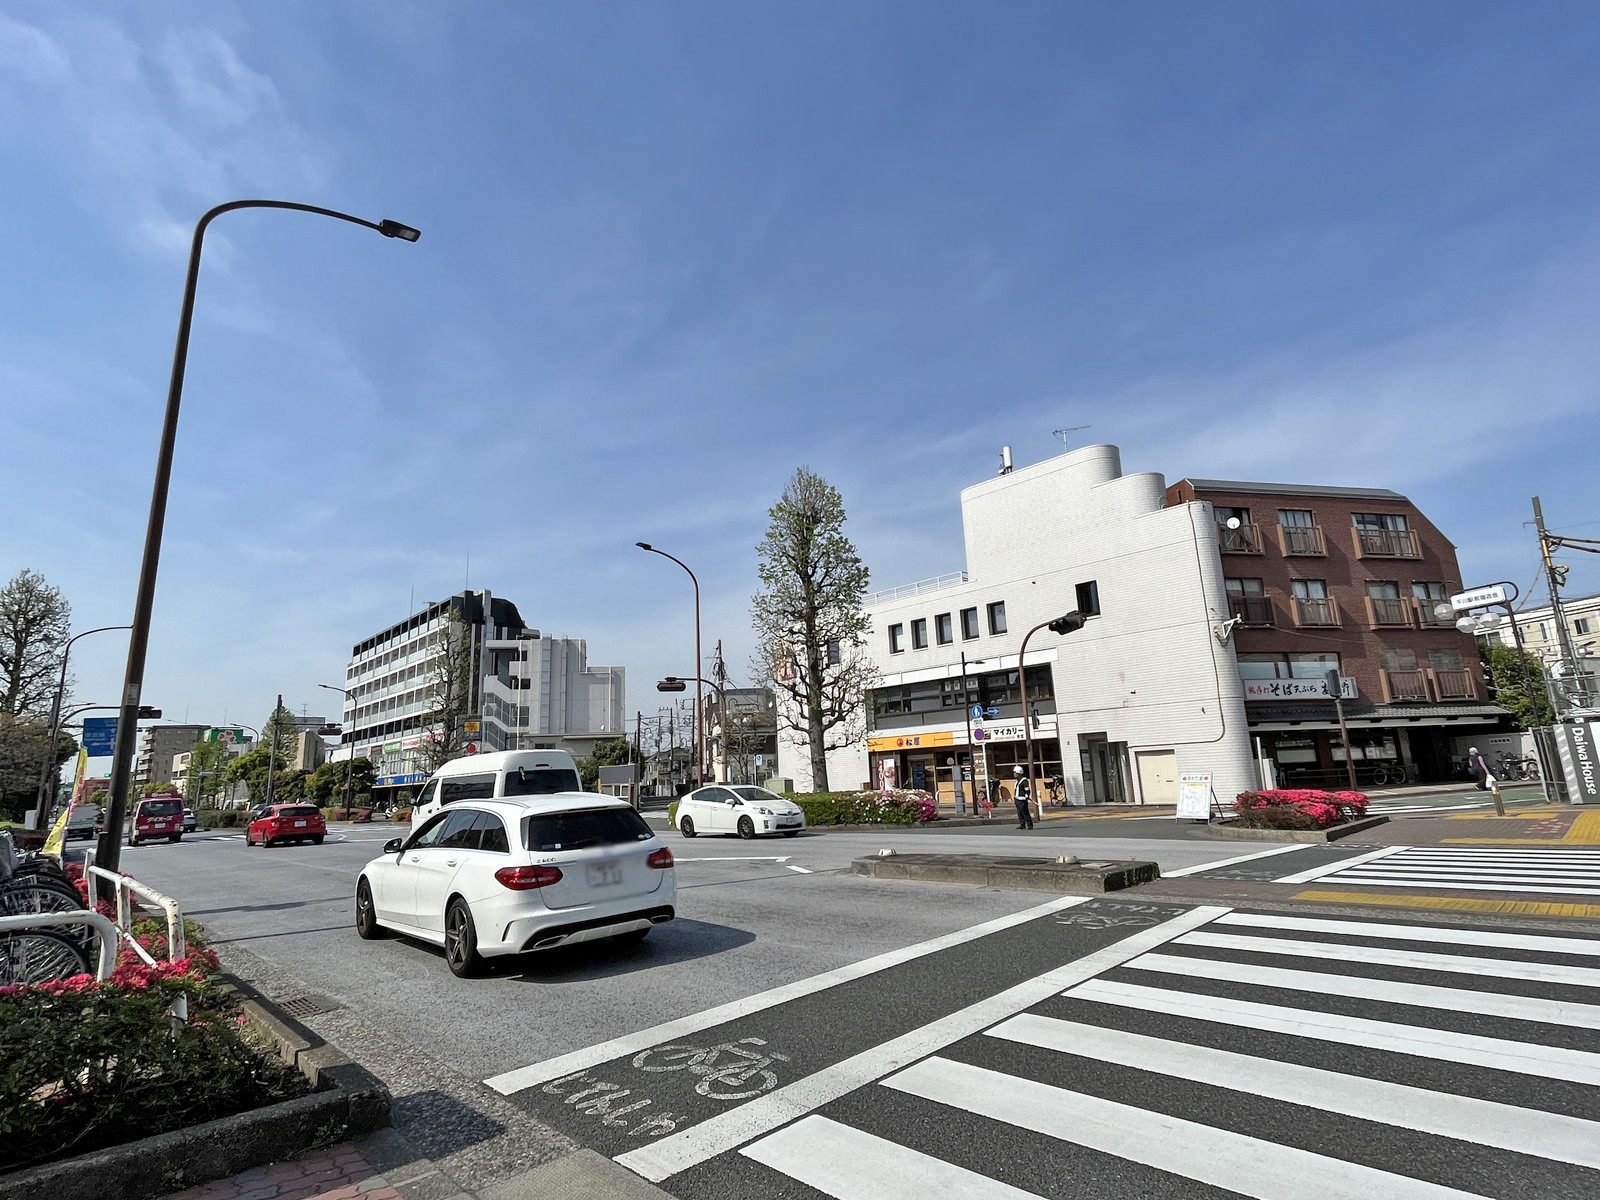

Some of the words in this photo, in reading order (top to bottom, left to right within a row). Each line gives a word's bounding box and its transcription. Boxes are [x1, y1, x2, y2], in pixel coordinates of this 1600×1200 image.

[993, 727, 1024, 736] マイカリー
[1571, 727, 1589, 761] Daiwa
[1581, 761, 1597, 795] House
